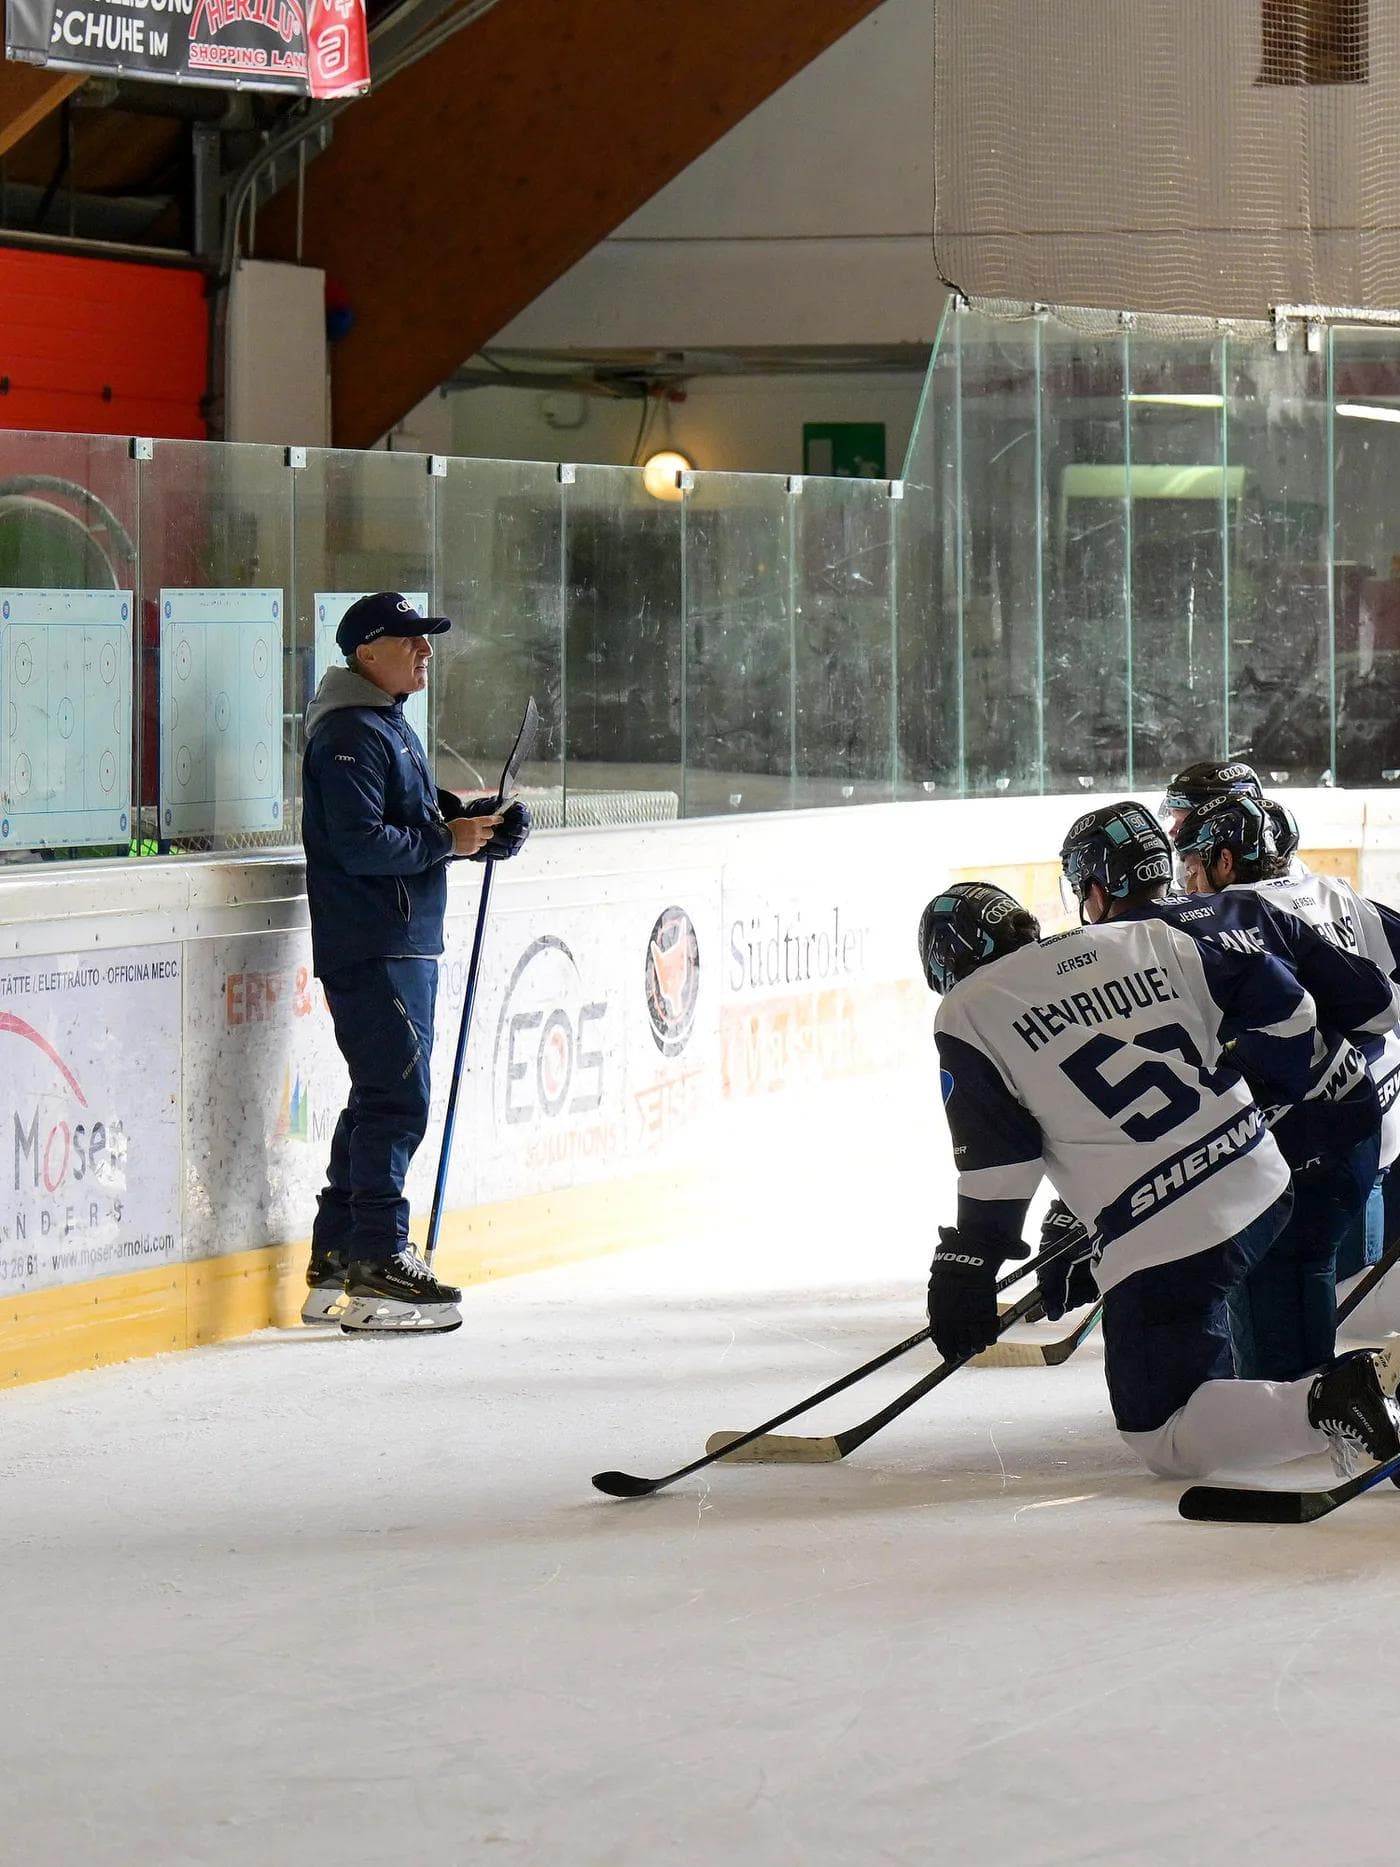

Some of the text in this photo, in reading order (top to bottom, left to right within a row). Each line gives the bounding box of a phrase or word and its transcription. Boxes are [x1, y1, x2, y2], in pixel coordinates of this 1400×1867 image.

[149, 30, 169, 58] IM
[190, 42, 266, 65] SHOPPING
[1178, 905, 1217, 924] JER53Y
[38, 969, 100, 991] ELETTRAUTO
[107, 964, 150, 984] OFFICINA
[151, 960, 180, 978] MECC.
[1055, 950, 1099, 976] JER53Y
[504, 1000, 608, 1125] EOS
[526, 1123, 618, 1168] SOLUTIONS
[52, 1233, 175, 1271] www.moser-arnold.com
